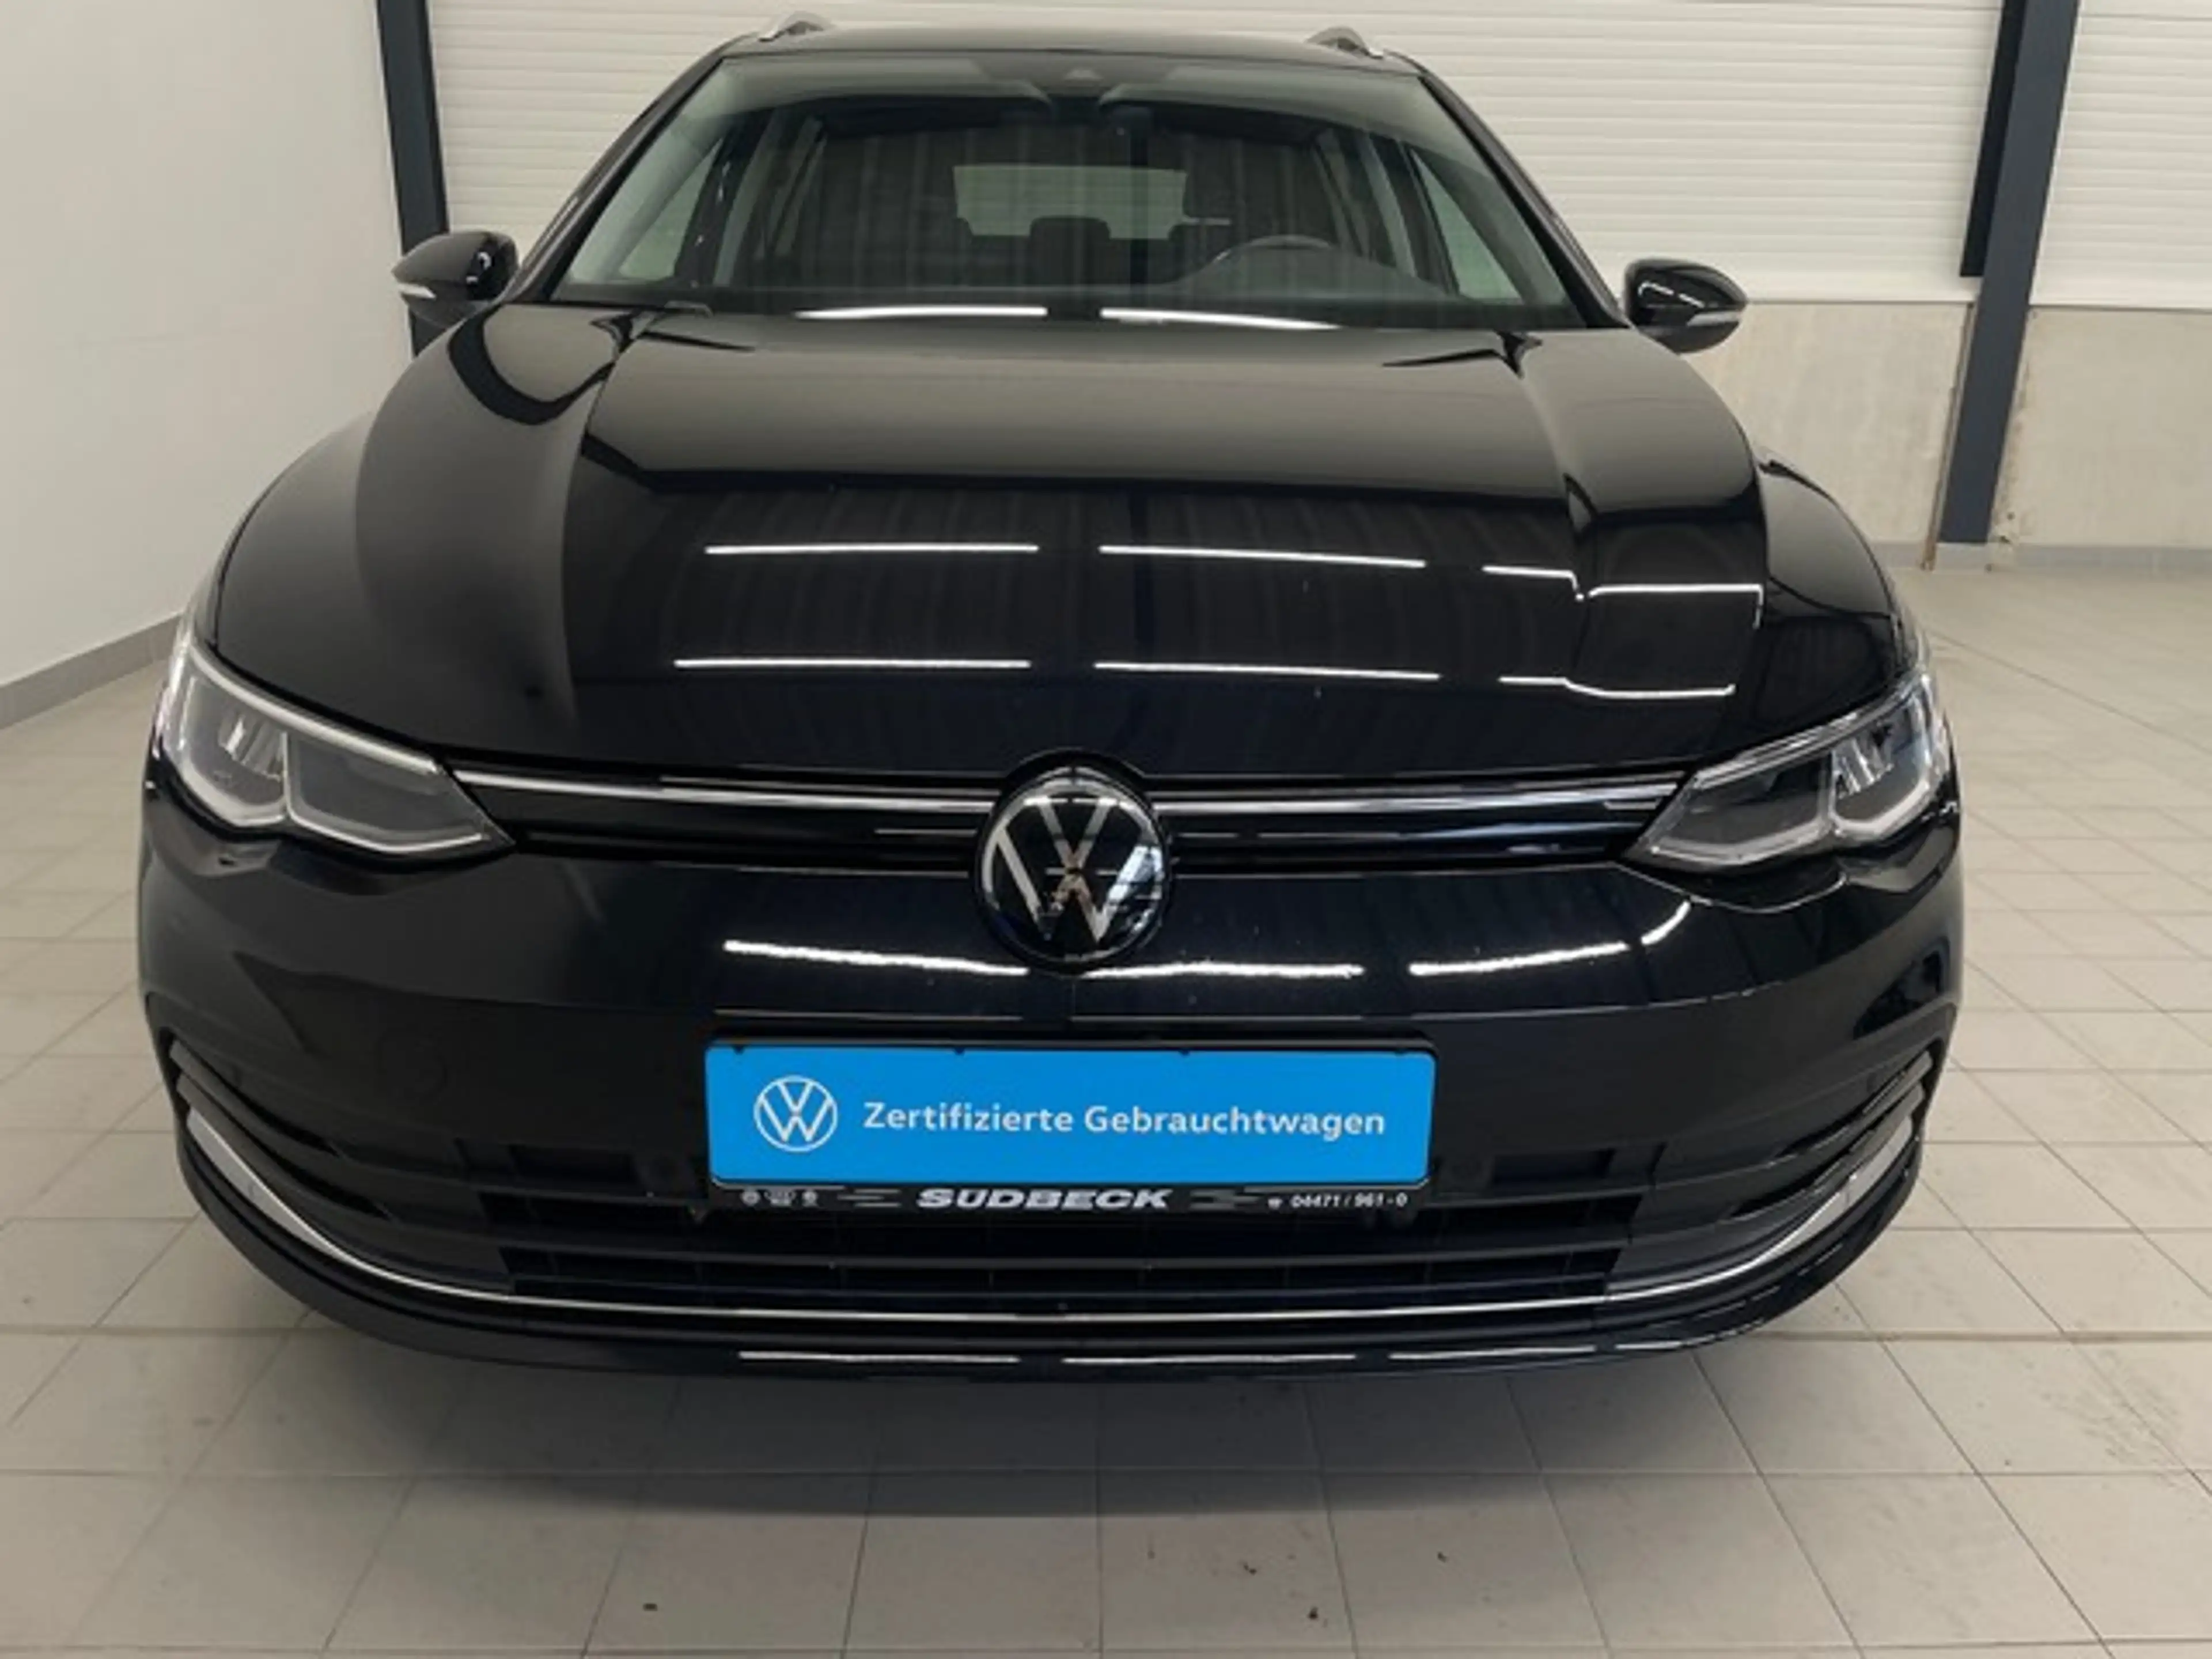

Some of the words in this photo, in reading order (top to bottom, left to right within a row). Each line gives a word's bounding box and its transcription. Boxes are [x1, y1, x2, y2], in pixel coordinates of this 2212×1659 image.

[987, 783, 1159, 950] VW
[755, 1077, 836, 1150] VW
[863, 1102, 1074, 1132] Zertifizierte
[1084, 1105, 1385, 1142] Gebrauchtwagen
